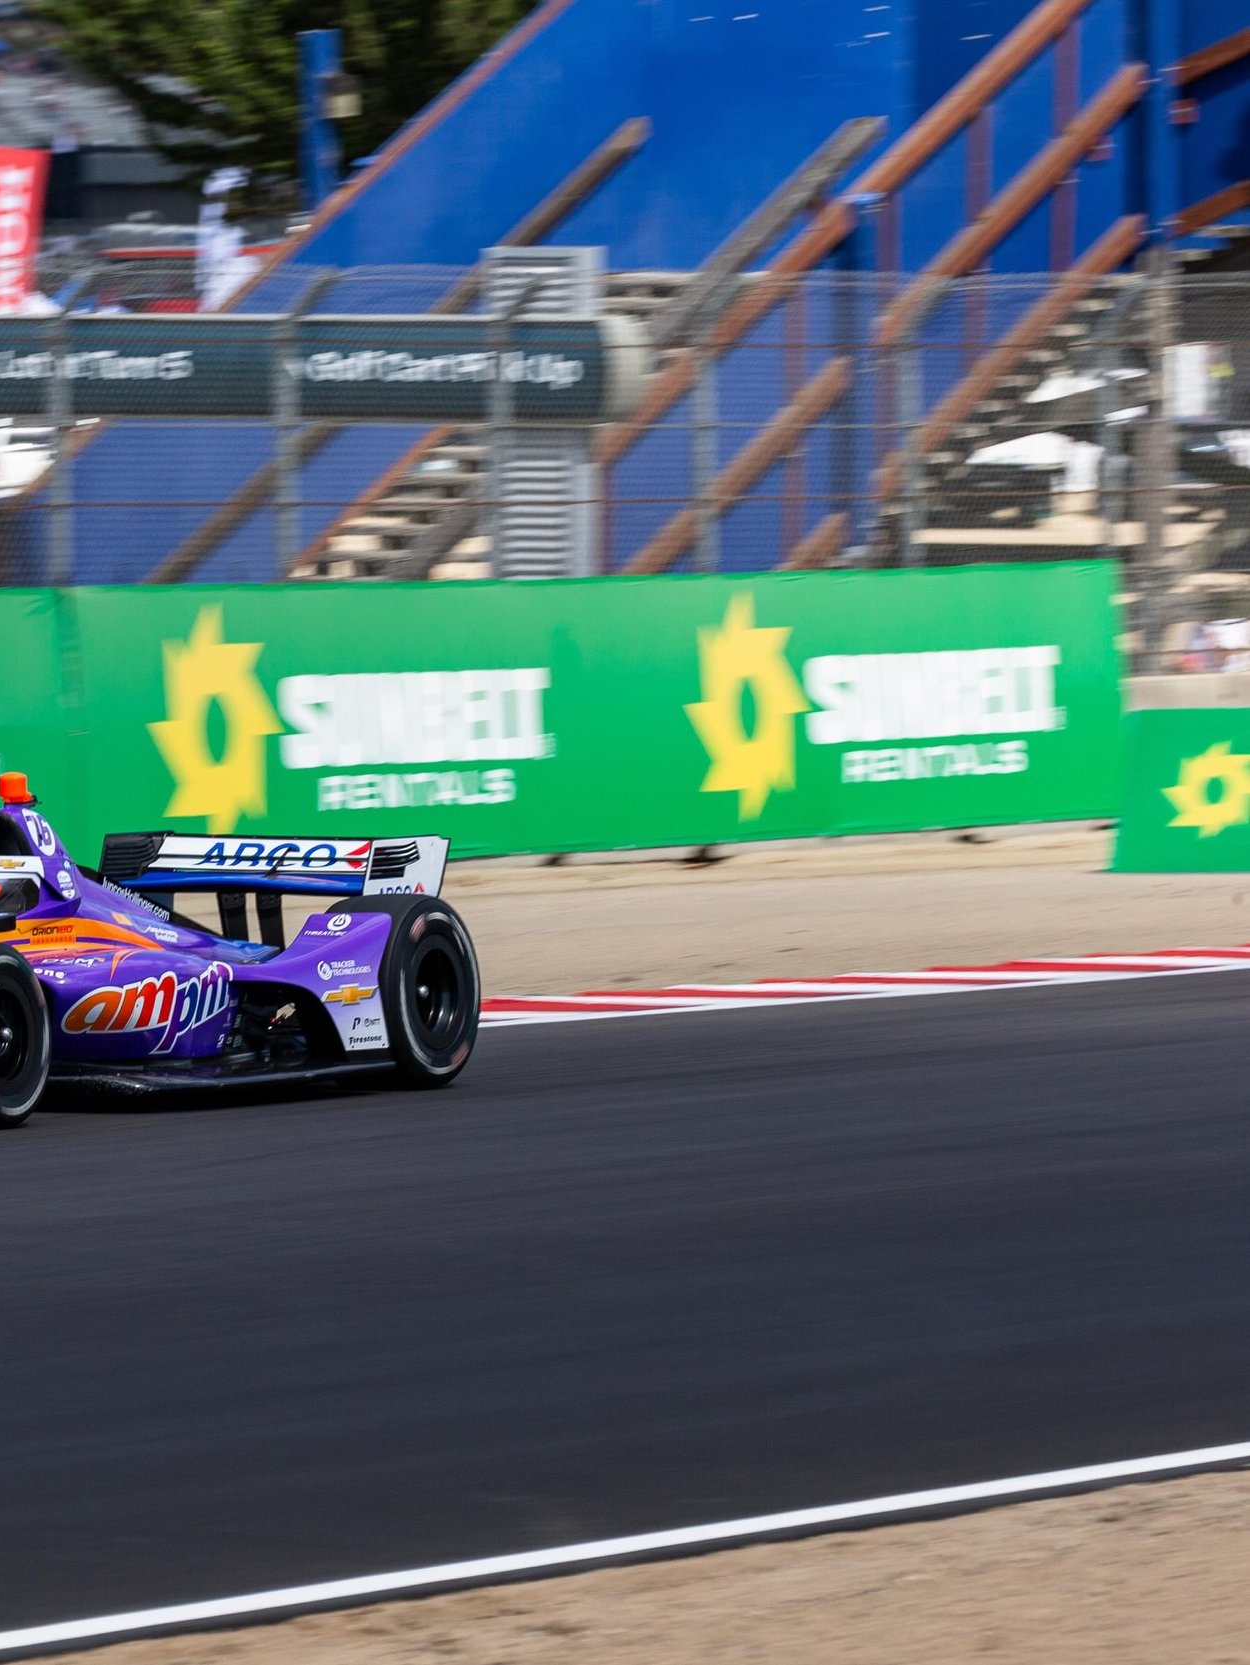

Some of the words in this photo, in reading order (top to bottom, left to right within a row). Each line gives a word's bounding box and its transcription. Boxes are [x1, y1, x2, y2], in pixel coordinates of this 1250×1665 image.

[452, 351, 530, 381] Pik
[802, 644, 1062, 744] SUNBELT
[276, 667, 552, 769] SUNBELT
[841, 740, 1029, 783] RENTALS
[317, 768, 516, 811] RENTALS
[195, 842, 338, 867] ARCO
[61, 961, 234, 1056] ampm
